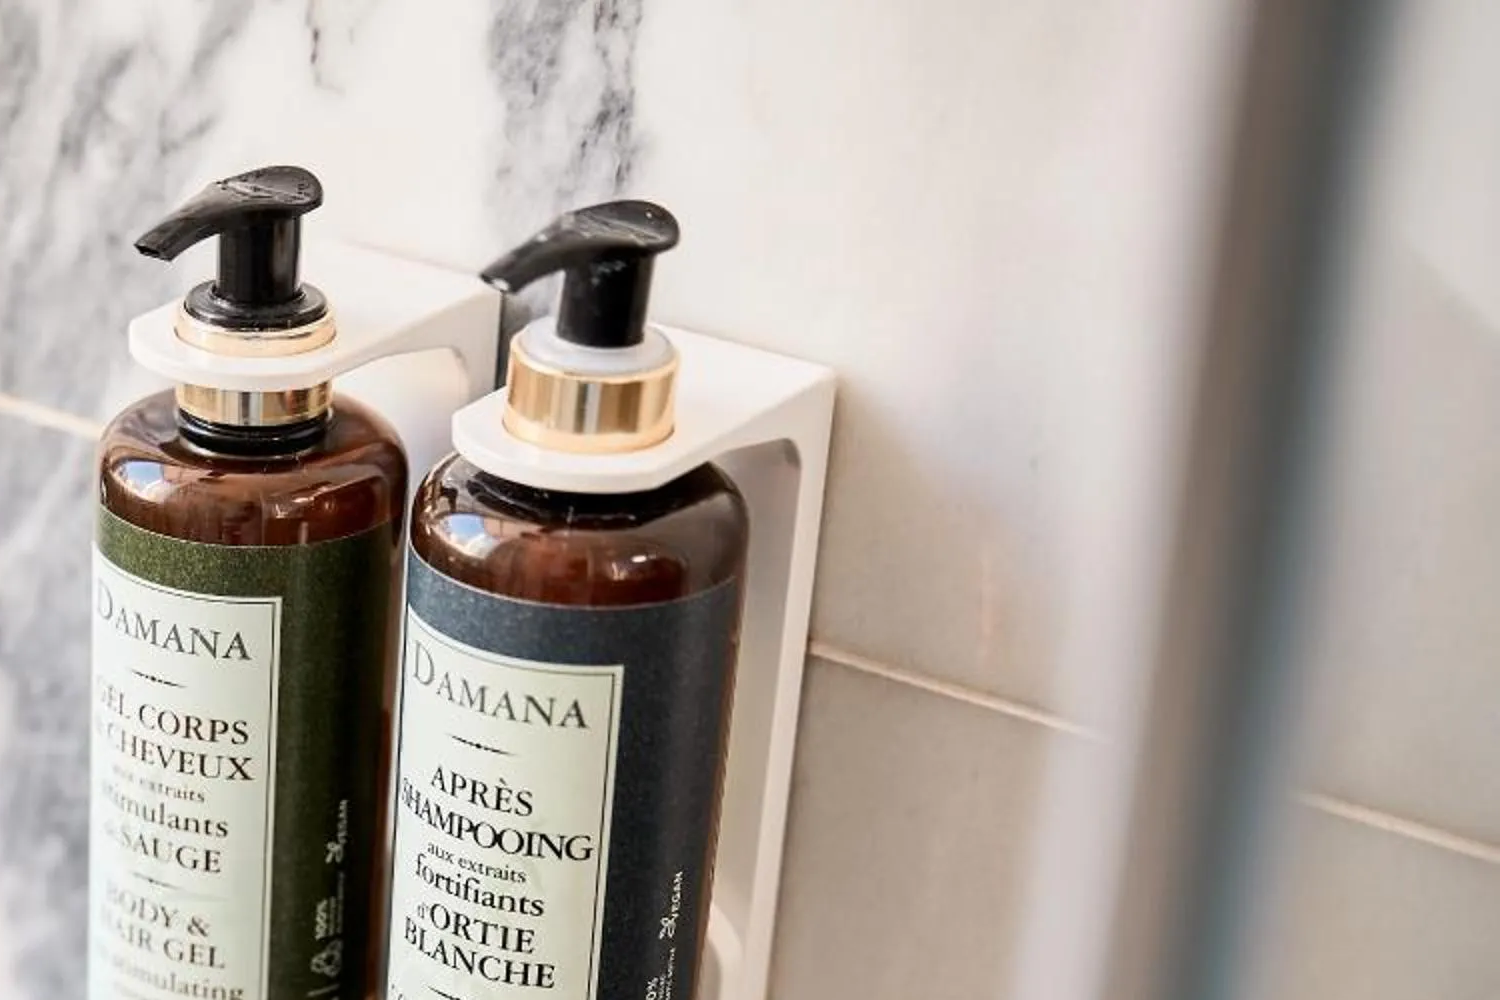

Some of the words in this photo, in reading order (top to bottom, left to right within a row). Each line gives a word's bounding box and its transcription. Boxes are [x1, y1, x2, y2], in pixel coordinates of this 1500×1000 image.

[413, 640, 589, 729] DAMANA
[139, 703, 249, 745] CORPS
[431, 764, 533, 817] APRÈS
[415, 852, 545, 917] fortifiants
[427, 841, 453, 866] aux
[458, 856, 527, 884] extraits
[187, 915, 209, 938] &
[163, 937, 225, 969] GEL
[404, 915, 556, 989] BLANCHE
